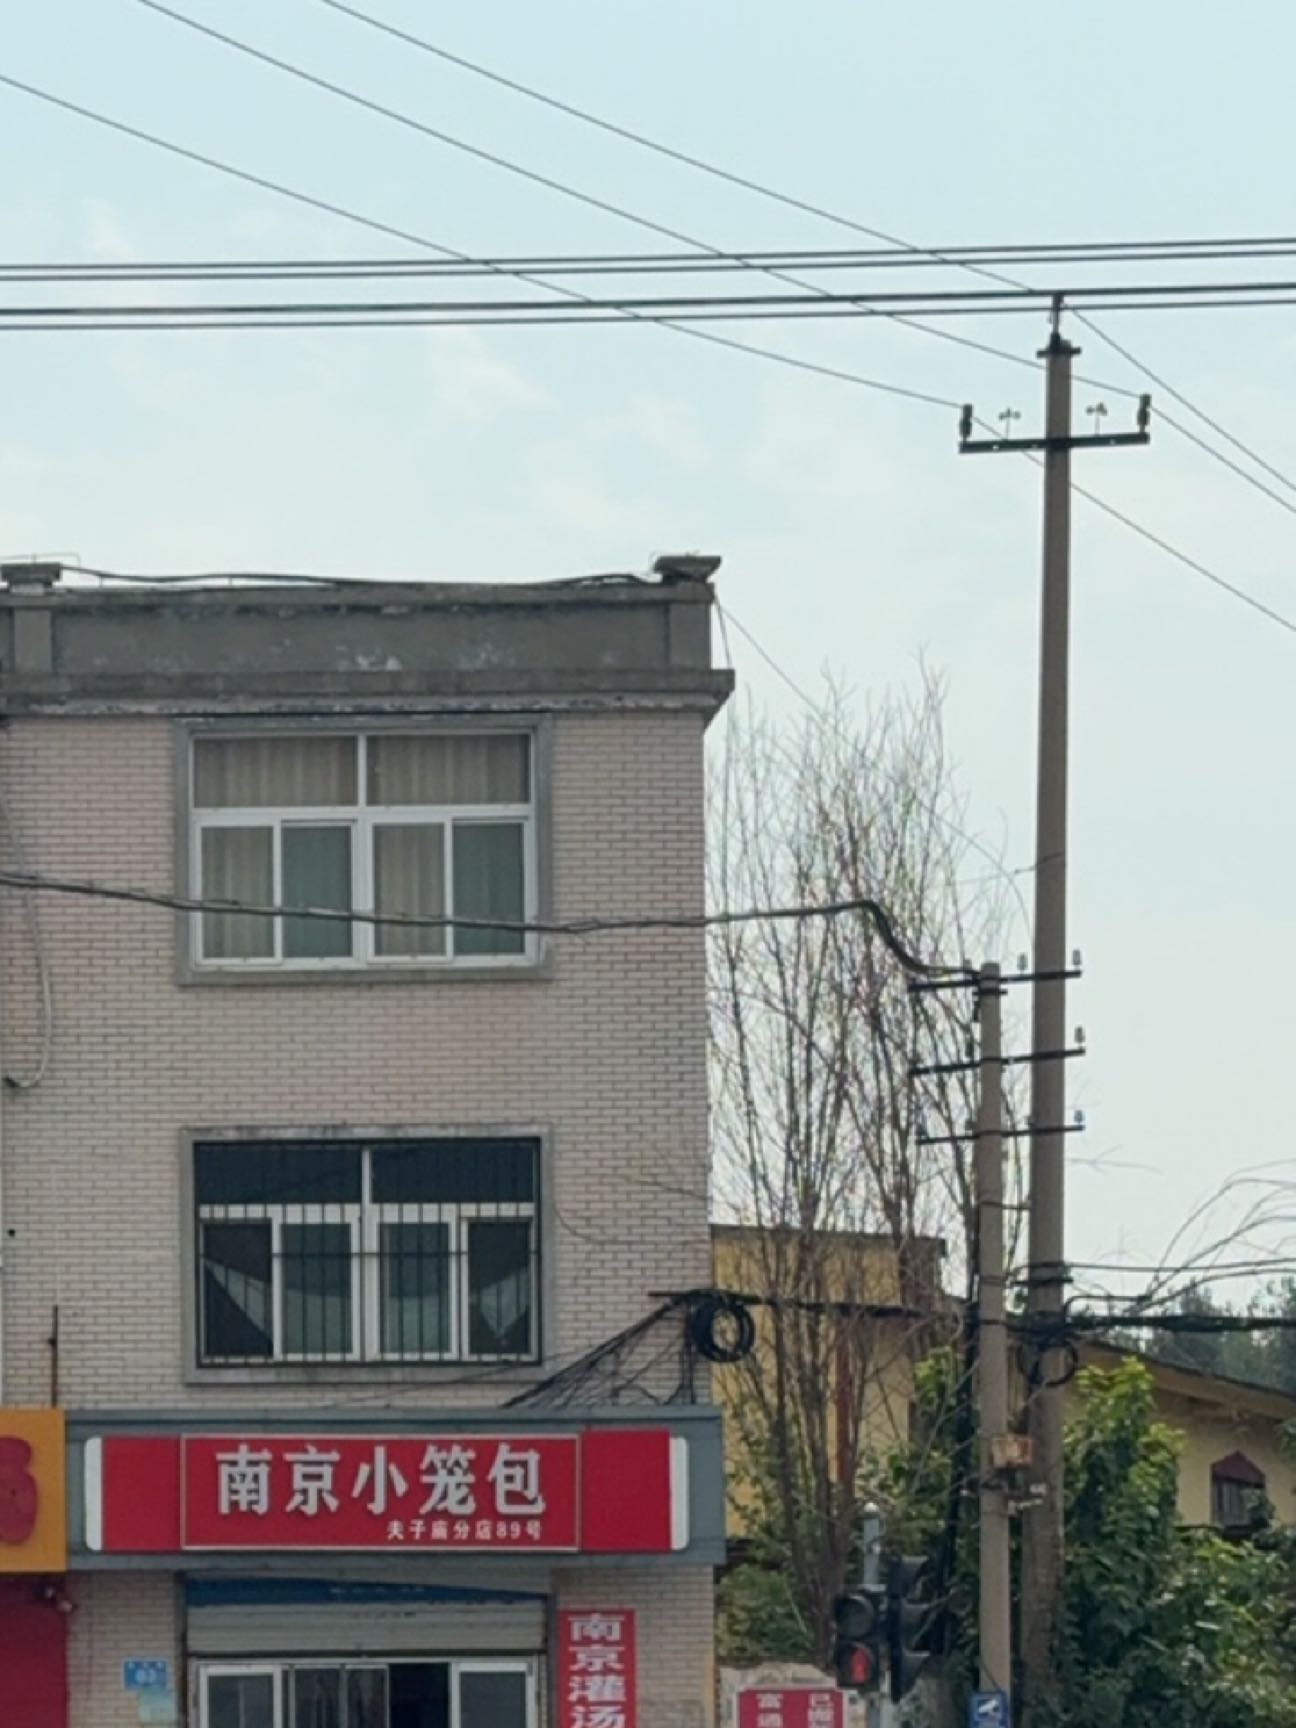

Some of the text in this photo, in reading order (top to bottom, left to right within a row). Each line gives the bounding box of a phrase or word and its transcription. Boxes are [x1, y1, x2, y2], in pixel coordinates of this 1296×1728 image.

[215, 1444, 547, 1516] 南京小笼包
[386, 1519, 542, 1541] 夫子庙分店89号
